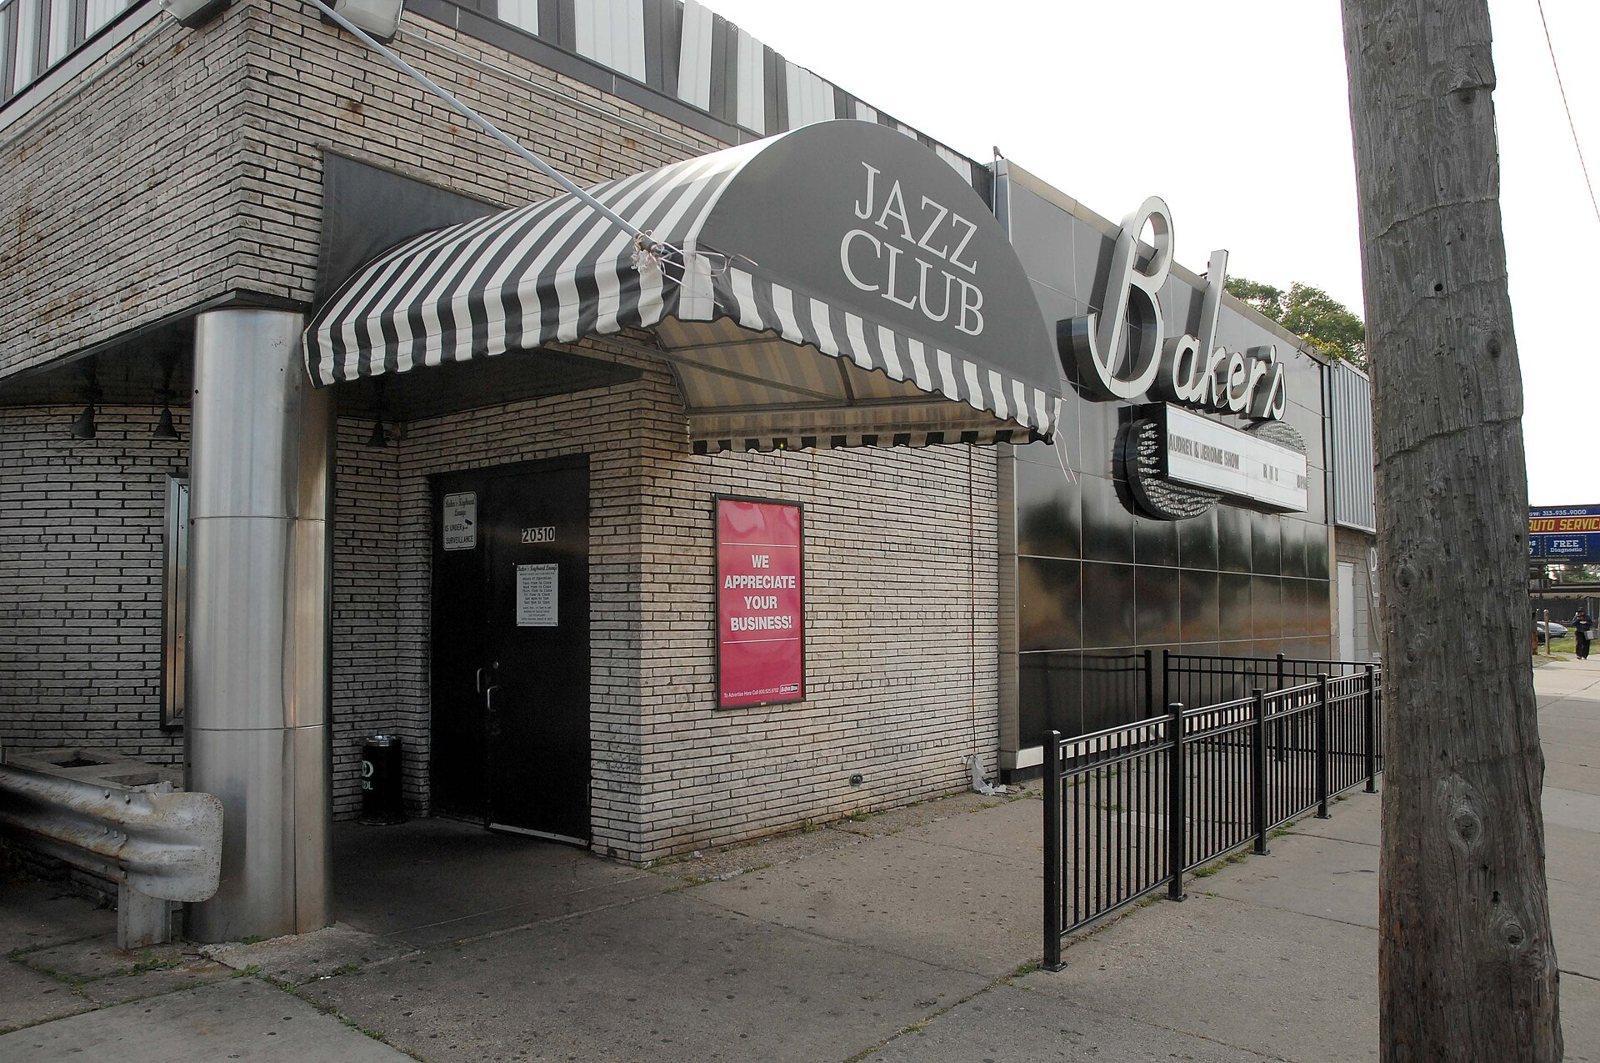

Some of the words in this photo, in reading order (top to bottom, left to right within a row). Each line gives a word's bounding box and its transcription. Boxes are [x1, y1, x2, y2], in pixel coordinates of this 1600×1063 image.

[855, 161, 978, 275] JAZZ
[841, 229, 984, 336] CLUB
[1086, 196, 1286, 421] Baker's
[1168, 434, 1193, 456] AUDREY
[1200, 443, 1223, 466] JEROME
[1224, 451, 1240, 470] SHOW
[1559, 518, 1600, 531] SERVIC
[522, 527, 555, 543] 20510
[751, 555, 769, 568] WE
[724, 575, 796, 589] APPRECIATE
[744, 596, 778, 609] YOUR
[730, 616, 792, 631] BUSINESS!
